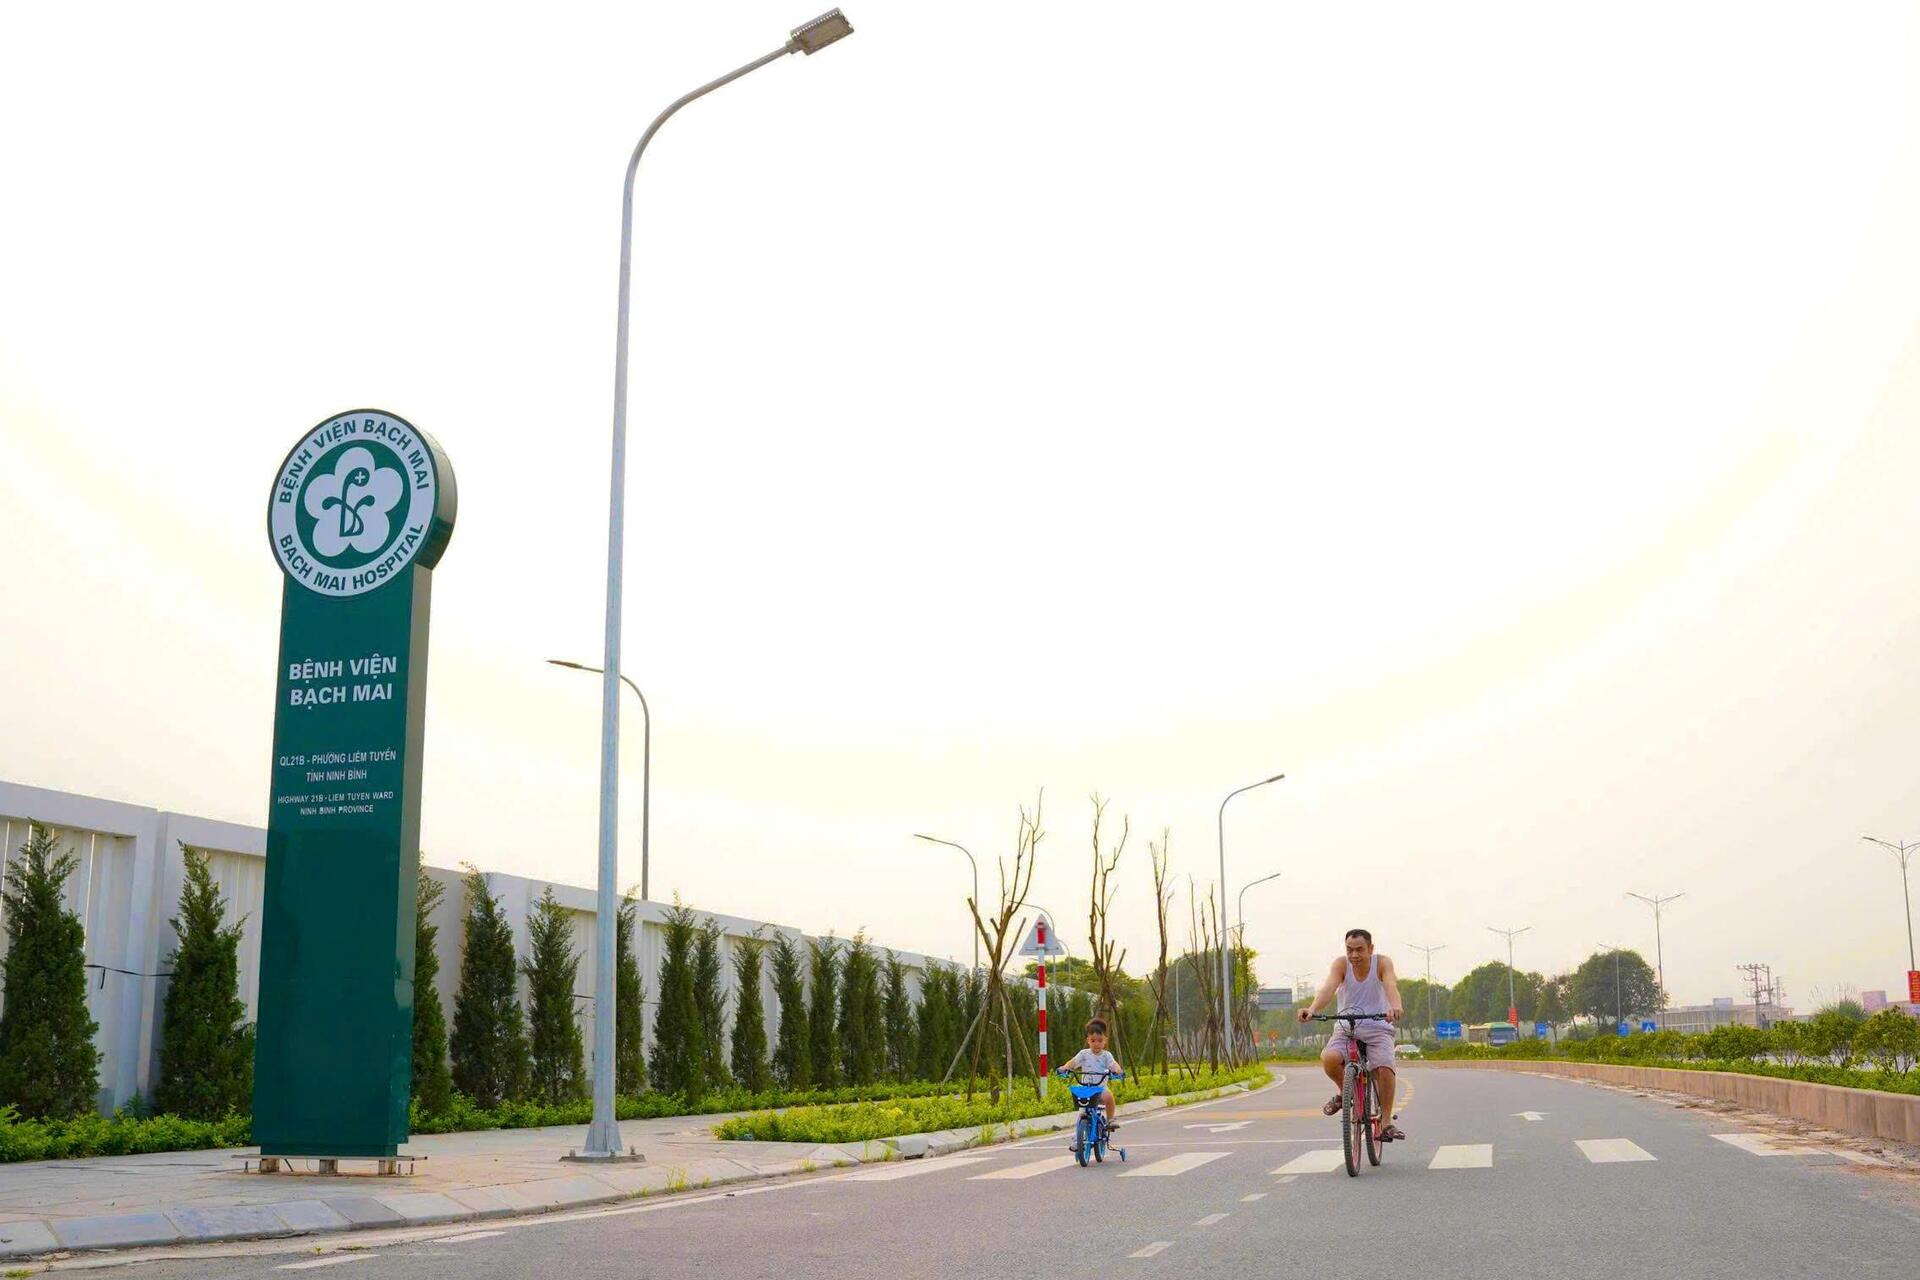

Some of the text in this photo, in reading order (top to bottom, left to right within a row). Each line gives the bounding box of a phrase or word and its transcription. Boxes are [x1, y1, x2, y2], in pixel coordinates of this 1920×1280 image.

[279, 418, 430, 503] BỆNH VIỆN BẠCH MAI
[280, 524, 424, 590] BACH MAI HOSPITAL
[289, 653, 397, 684] BỆNH VIỆN
[290, 683, 393, 710] BẠCH MAI
[280, 755, 305, 766] QL21B
[326, 771, 346, 781] NINH
[278, 795, 309, 804] HIGHWAY
[328, 794, 345, 802] LIEM
[347, 792, 370, 801] TUYEN
[372, 791, 394, 800] WARD
[300, 804, 374, 816] NINH BINH PROVINCE
